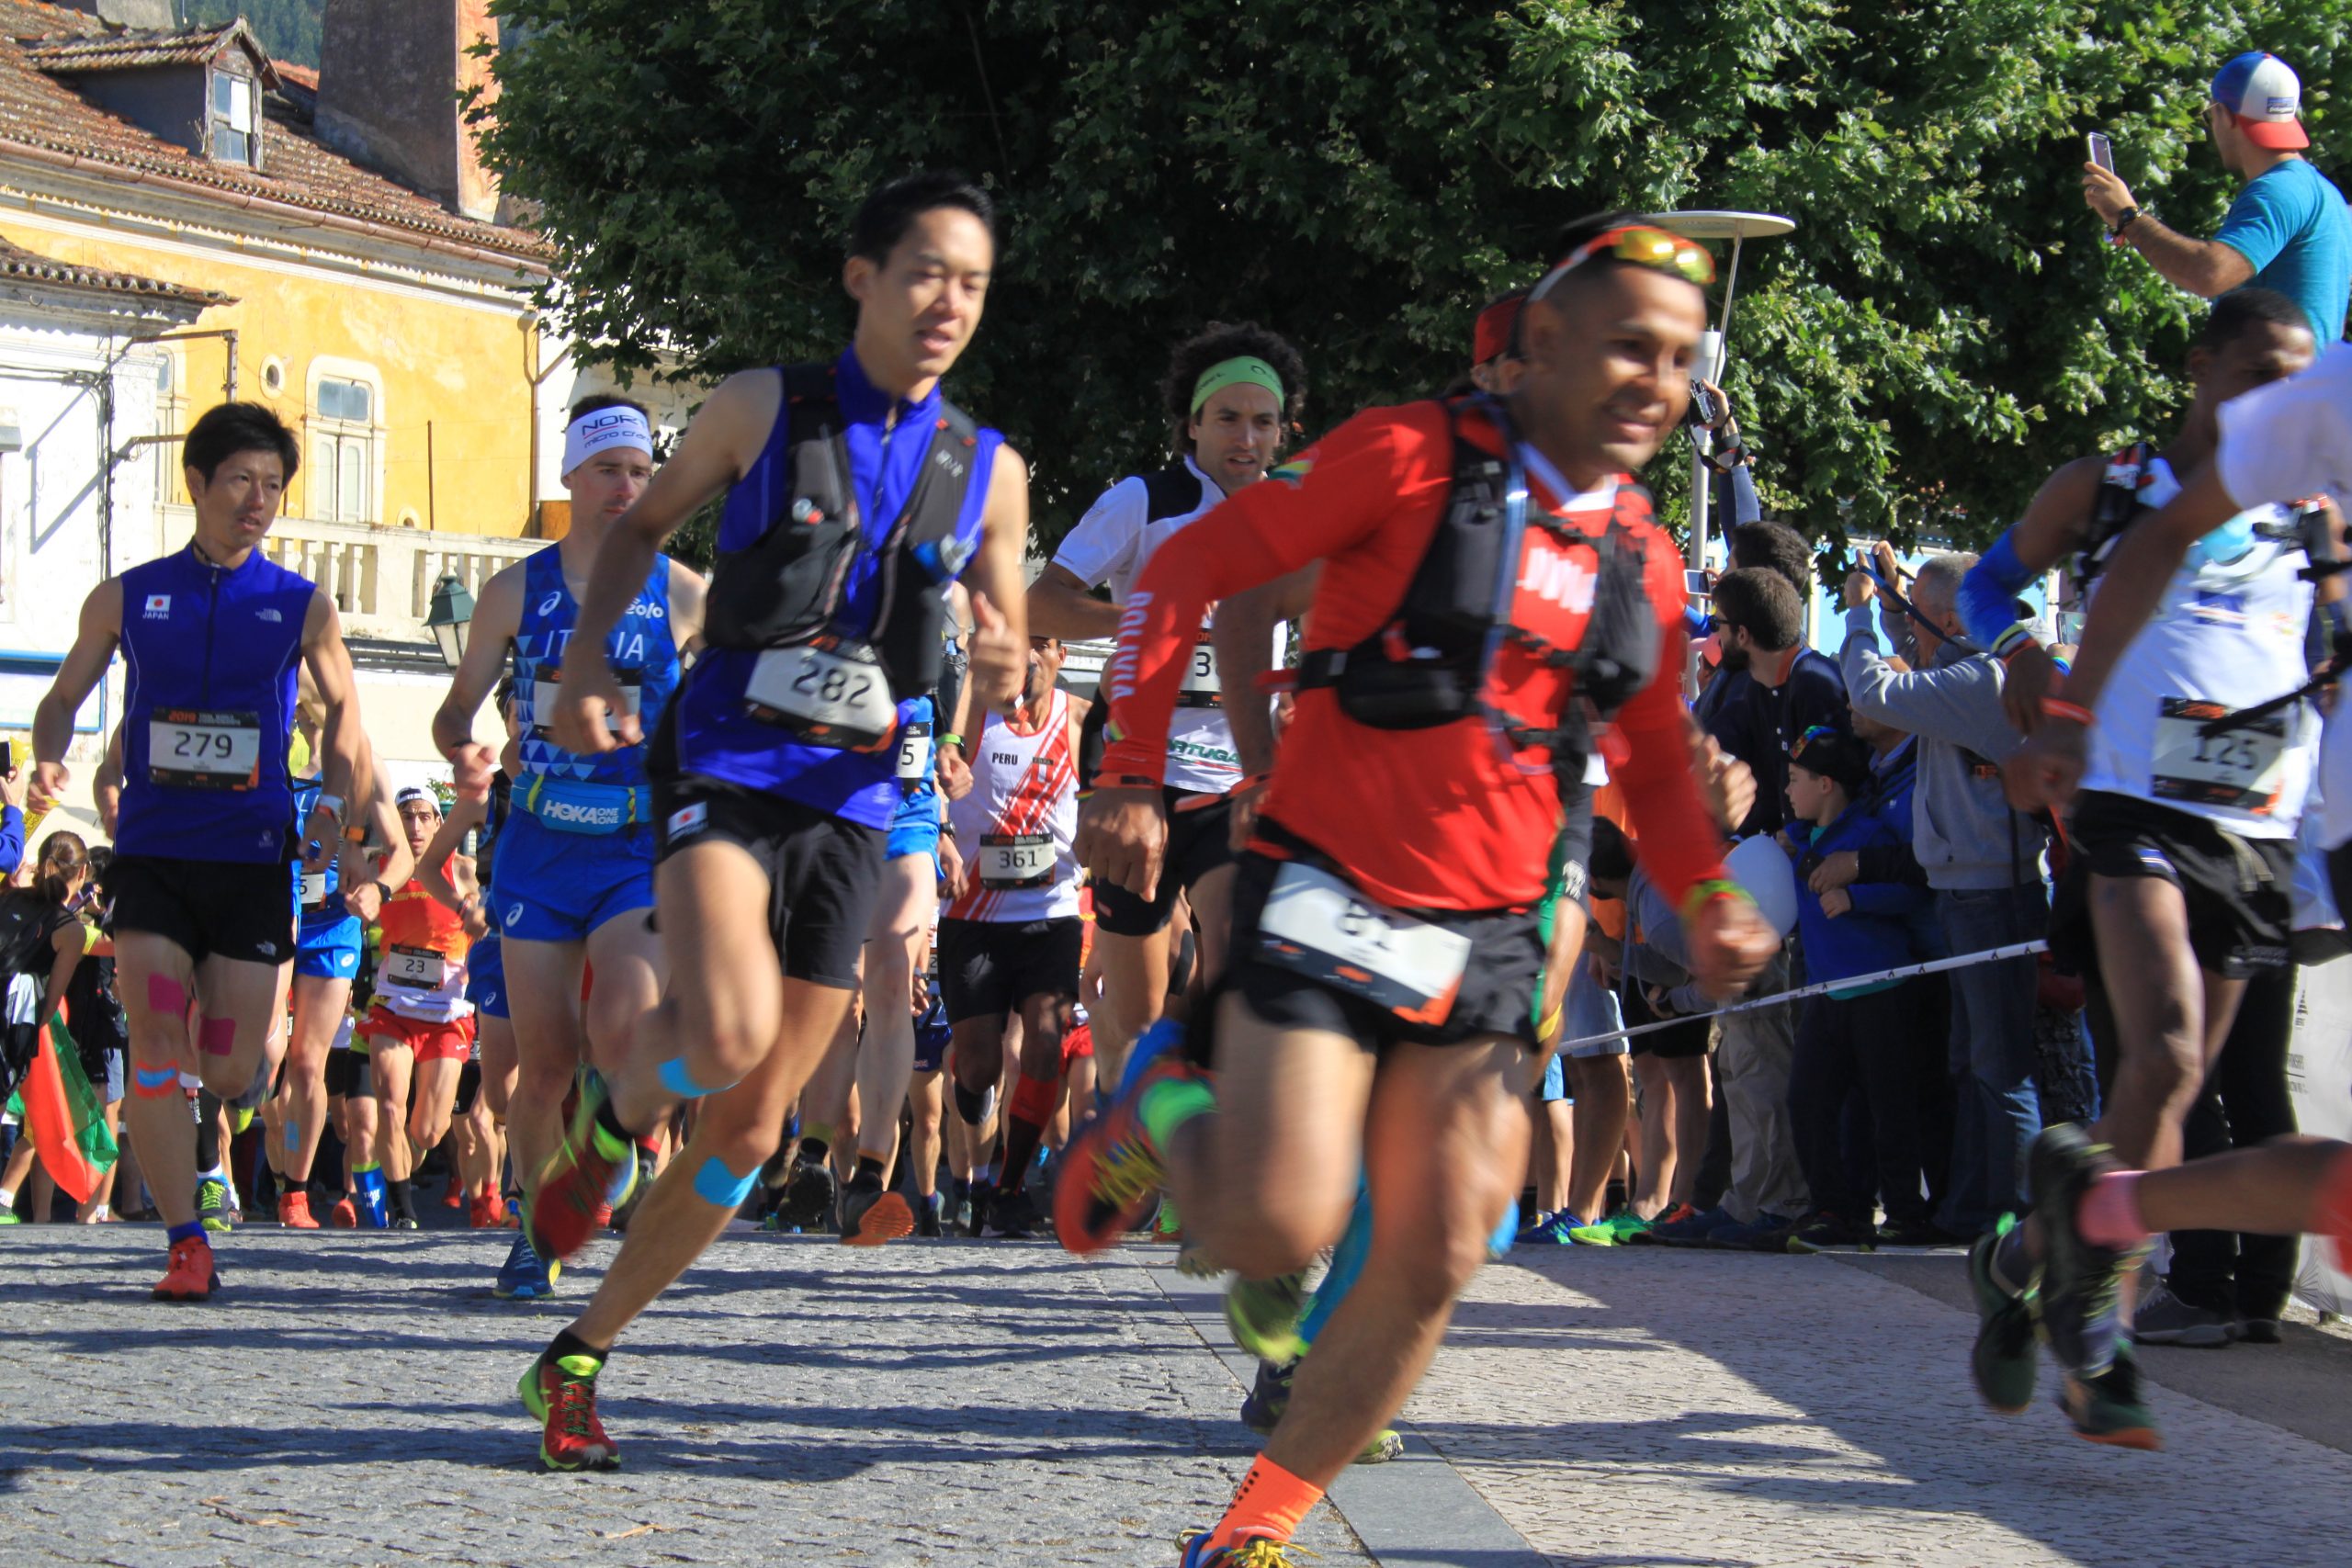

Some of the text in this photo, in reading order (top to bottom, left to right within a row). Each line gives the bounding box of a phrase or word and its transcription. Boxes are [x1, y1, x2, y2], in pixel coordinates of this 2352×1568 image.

[142, 611, 170, 620] JAPAN
[543, 629, 644, 661] ITIA
[1109, 592, 1155, 701] BOLIVIA
[792, 656, 872, 709] 282
[175, 730, 232, 760] 279
[992, 751, 1019, 765] PERU
[543, 799, 619, 824] HOKA ONE
[597, 816, 619, 825] ONE
[999, 850, 1038, 869] 361
[405, 958, 425, 974] 23
